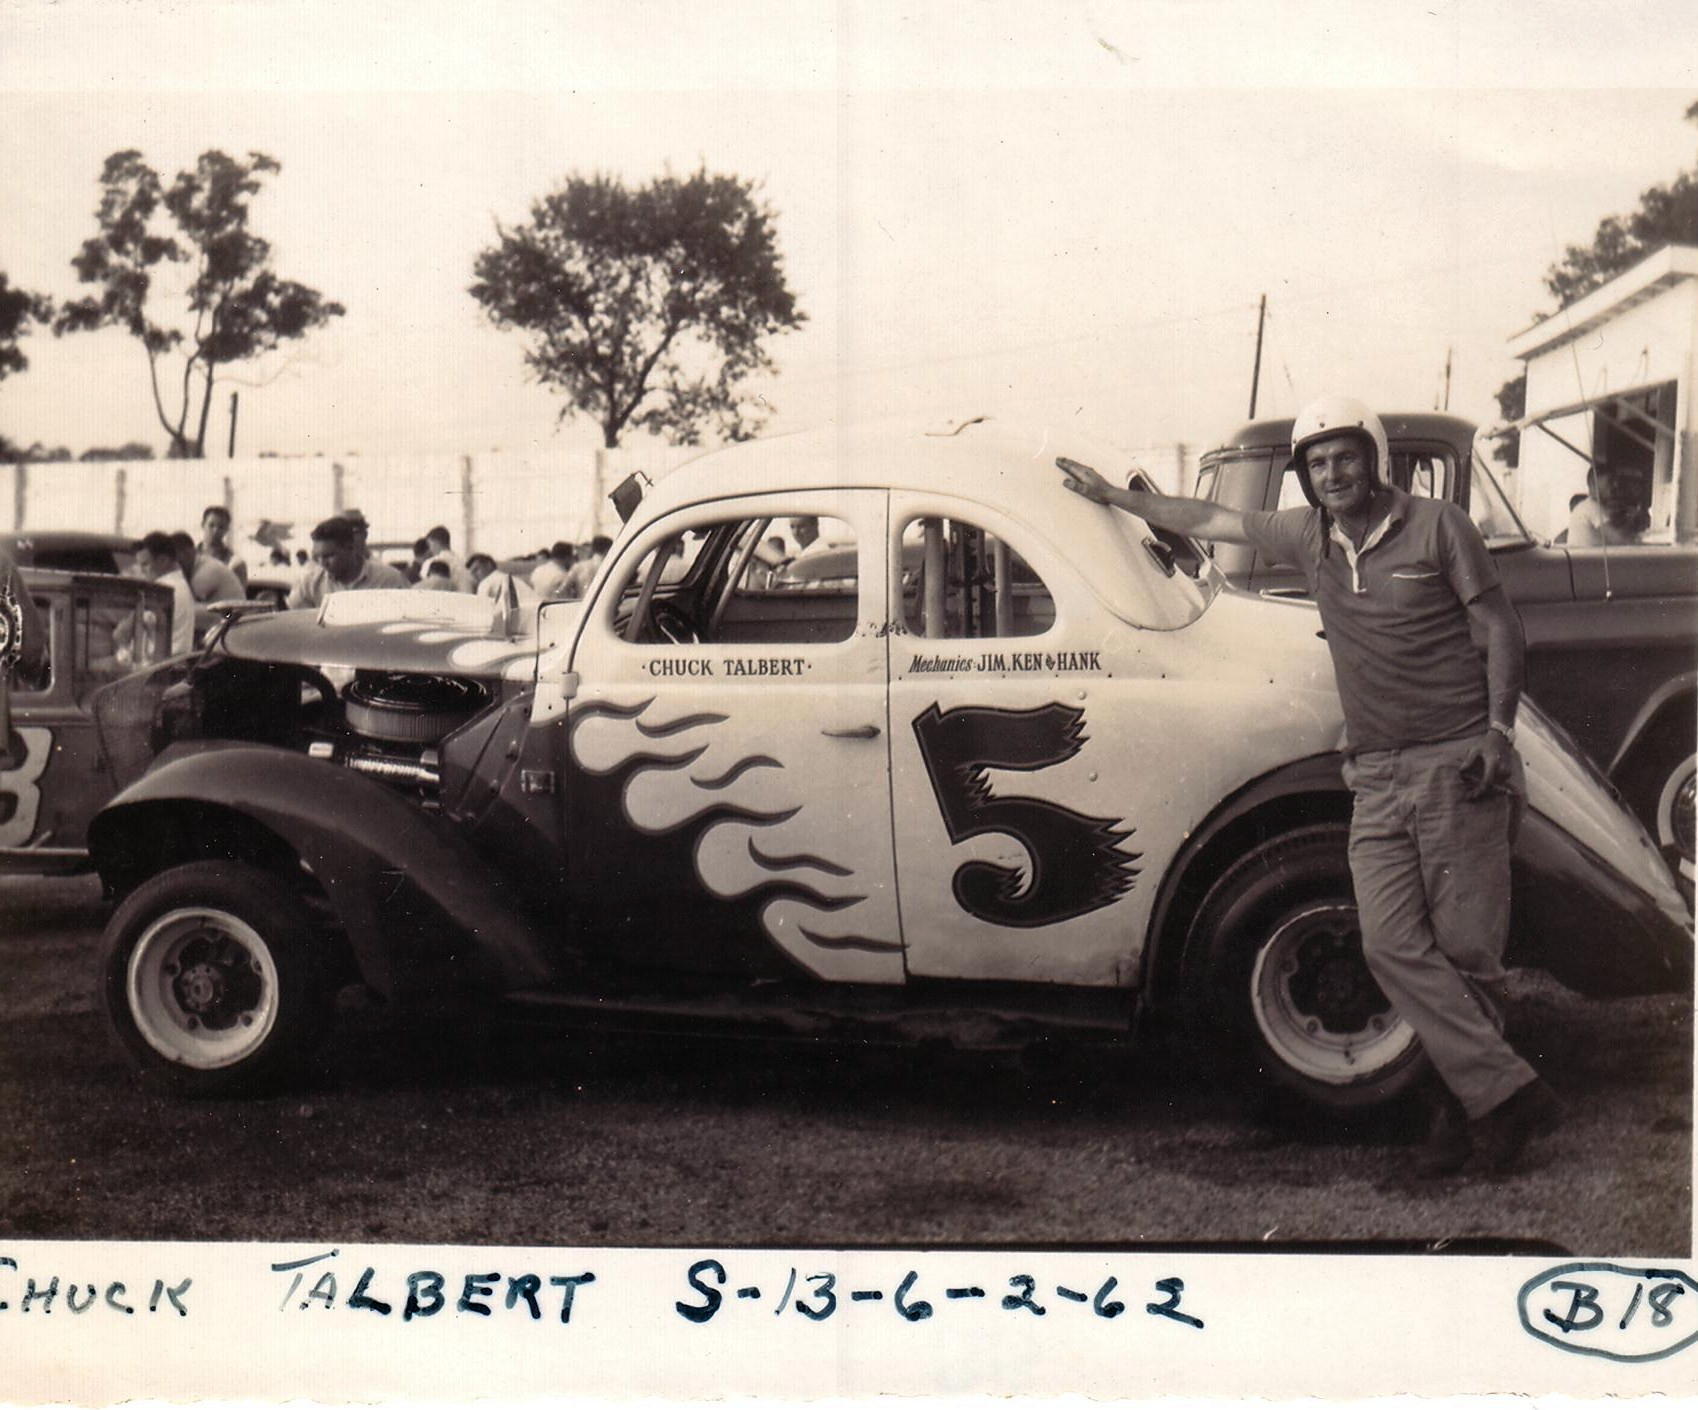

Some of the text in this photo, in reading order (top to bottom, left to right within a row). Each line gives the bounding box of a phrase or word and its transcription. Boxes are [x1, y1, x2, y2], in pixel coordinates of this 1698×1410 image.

[1057, 652, 1102, 671] HANK
[911, 701, 1145, 929] 5
[271, 1248, 596, 1324] TALBERT
